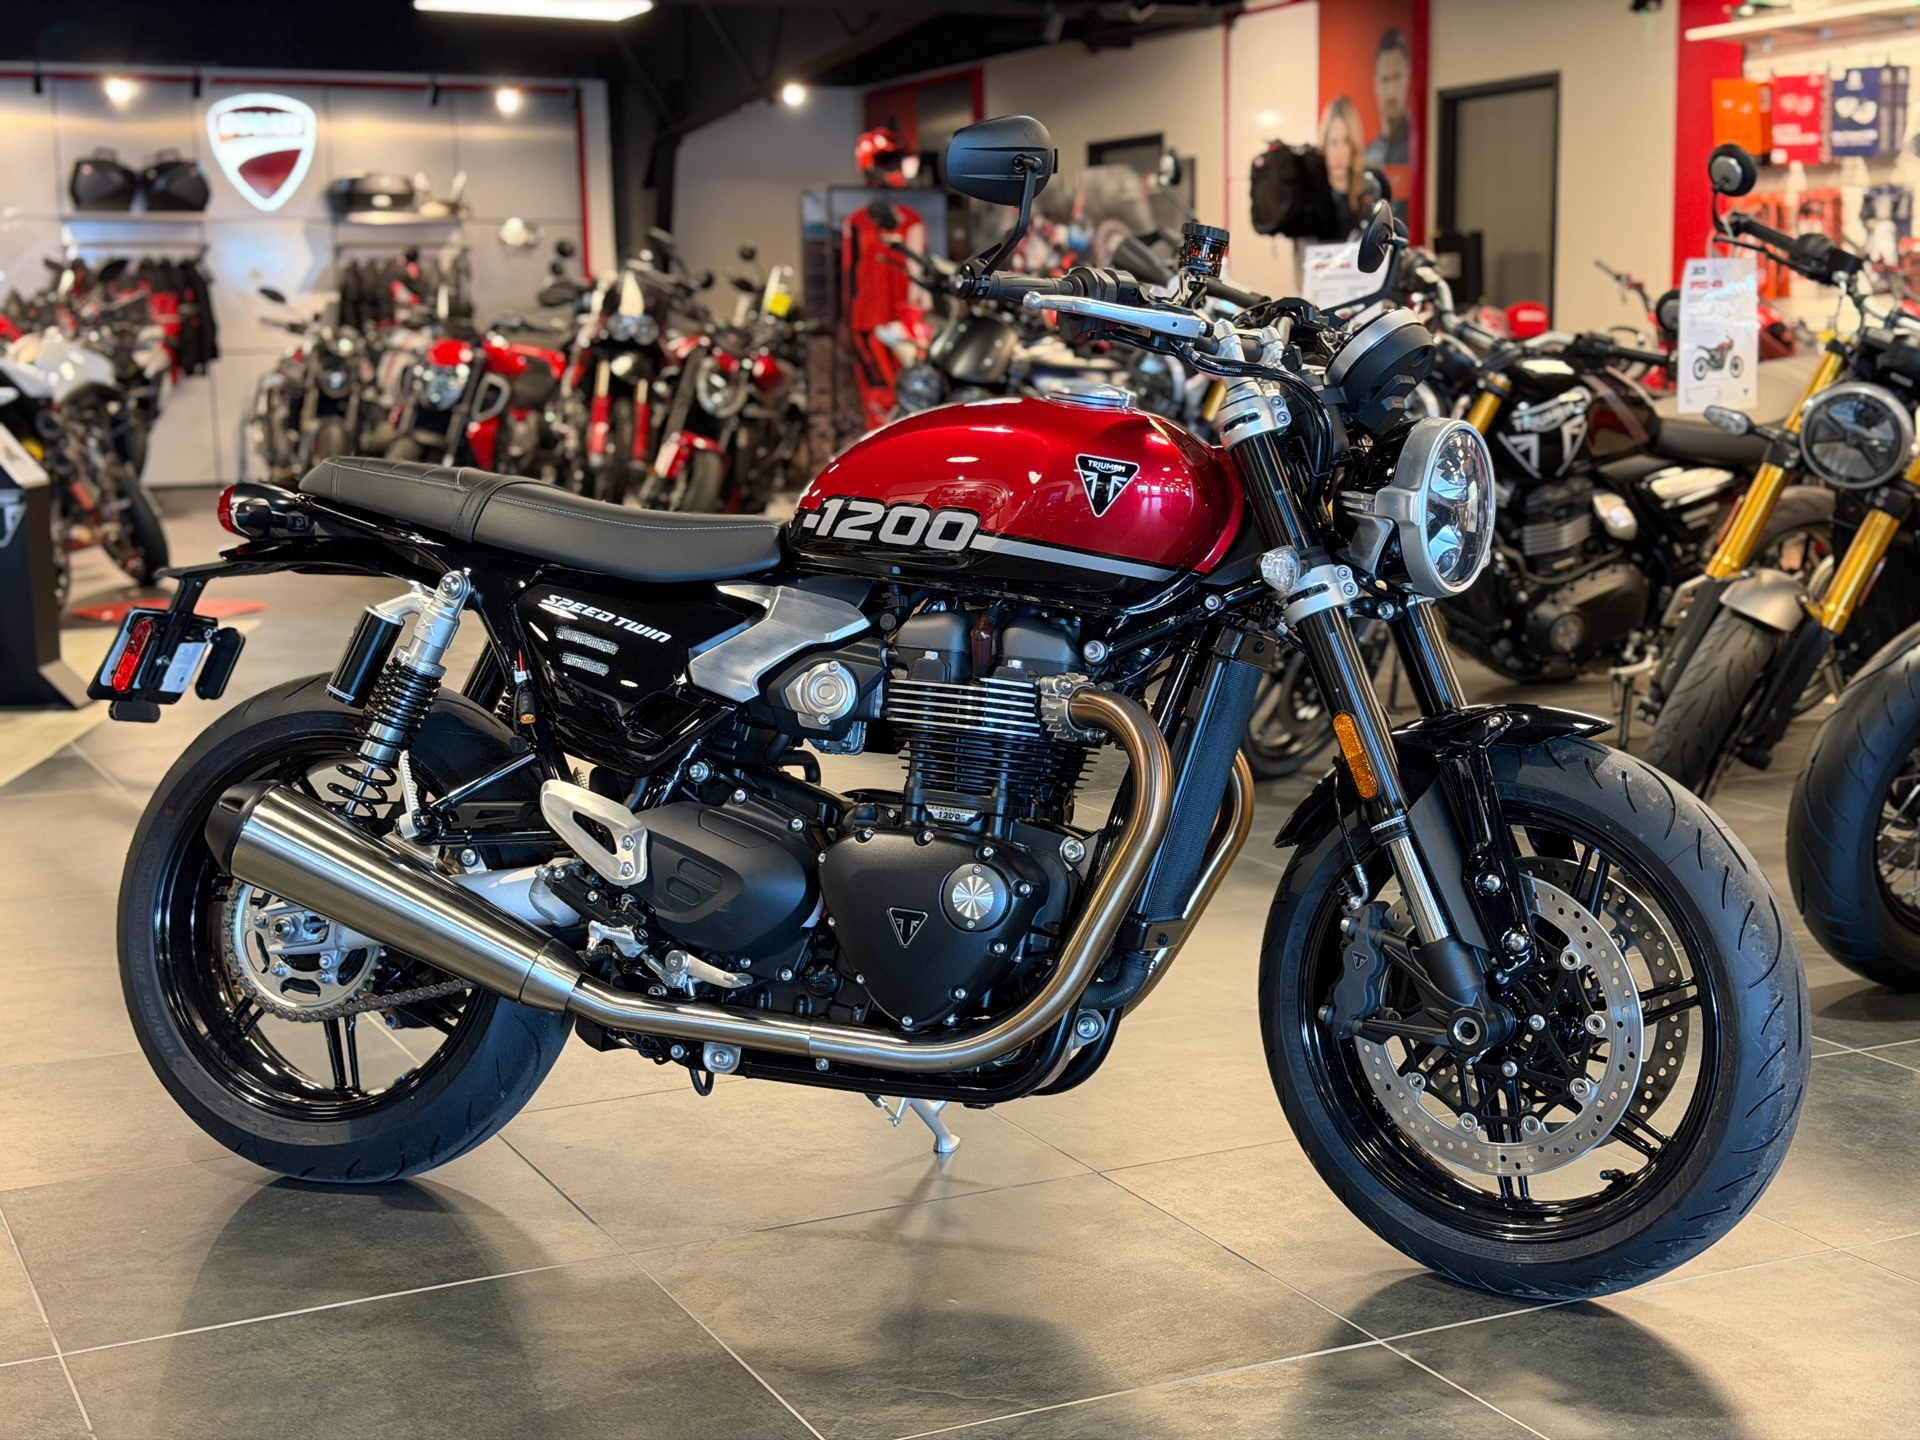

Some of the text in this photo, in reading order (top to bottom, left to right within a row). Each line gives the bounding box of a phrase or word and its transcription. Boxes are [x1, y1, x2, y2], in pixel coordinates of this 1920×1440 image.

[1087, 459, 1126, 474] TRIUMPH
[815, 498, 979, 551] 1200
[541, 594, 672, 643] SPEED TWIN
[938, 811, 961, 820] 1200
